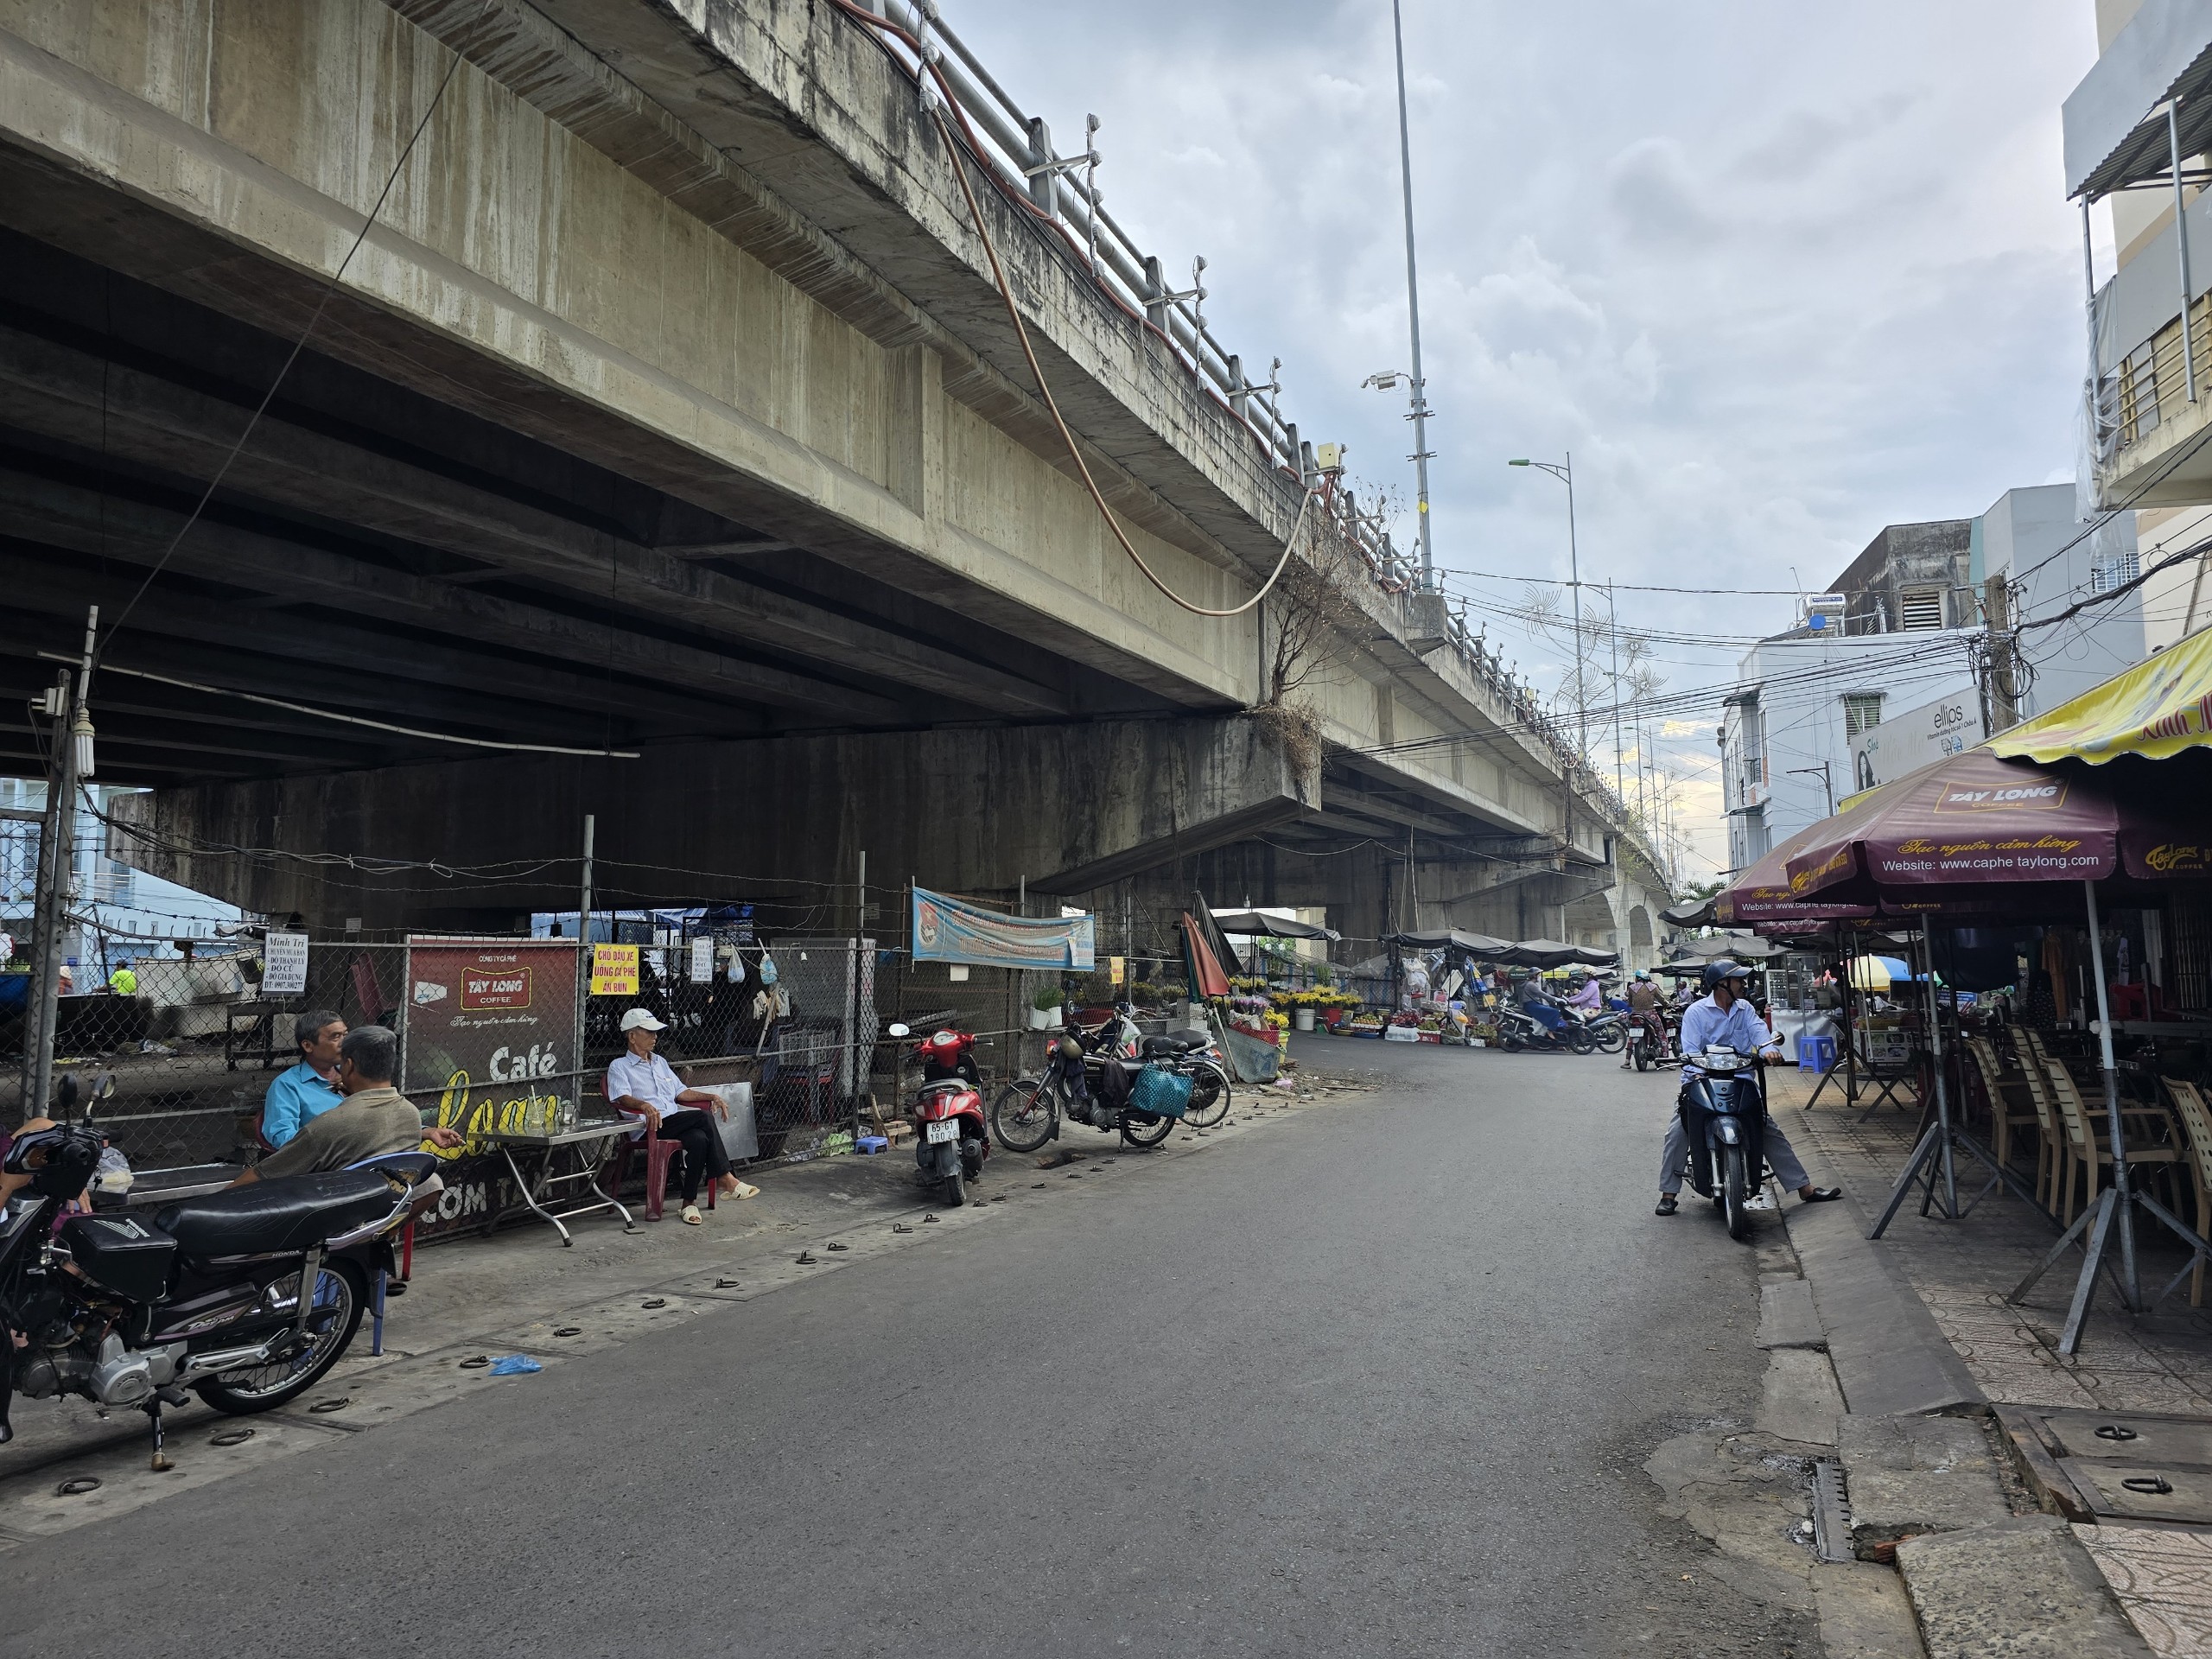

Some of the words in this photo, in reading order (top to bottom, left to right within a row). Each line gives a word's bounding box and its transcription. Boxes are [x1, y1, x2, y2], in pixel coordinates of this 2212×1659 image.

[1935, 704, 1963, 729] ellips
[1948, 791, 1991, 802] TÂY
[1993, 786, 2058, 802] LONG
[1897, 839, 1937, 855] Tạo
[1940, 840, 1993, 857] nguồn
[1995, 838, 2032, 850] cảm
[2032, 835, 2082, 854] hứng
[1883, 861, 1936, 872] Website:
[1940, 856, 2013, 869] www.caphe
[2018, 855, 2099, 869] taylong.com
[1742, 903, 1774, 912] Website:
[269, 938, 289, 947] Minh
[294, 938, 305, 948] Trí
[626, 951, 634, 962] XE
[594, 963, 614, 976] UỐNG
[623, 966, 636, 977] PHÊ
[468, 979, 490, 993] TÂY
[492, 980, 523, 993] LONG
[602, 981, 612, 993] ĂN
[613, 981, 627, 993] BÚN
[450, 1016, 471, 1027] Tạo
[490, 1041, 557, 1081] Café
[931, 1121, 953, 1133] 65-G1
